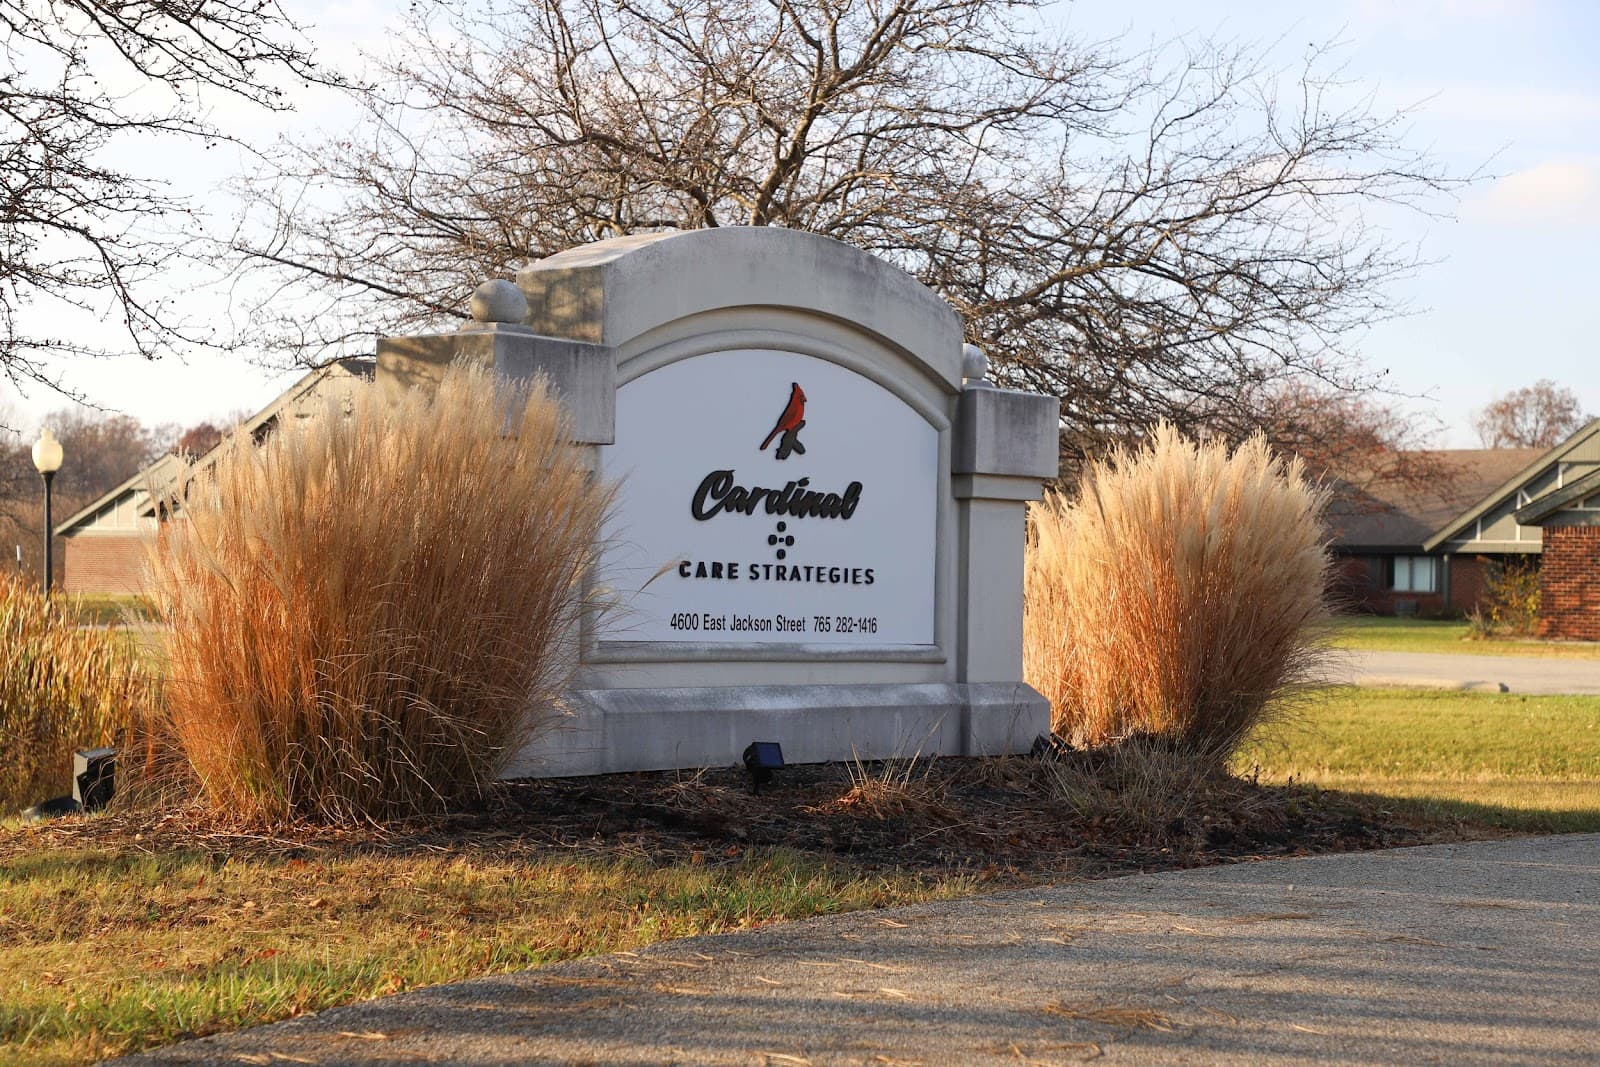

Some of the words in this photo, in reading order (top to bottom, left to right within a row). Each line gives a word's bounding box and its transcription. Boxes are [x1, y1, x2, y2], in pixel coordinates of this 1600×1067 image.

[691, 469, 863, 521] Cardinal
[679, 560, 739, 580] CARE
[749, 563, 875, 585] STRATEGIES
[670, 613, 699, 631] 4600
[703, 613, 726, 632] East
[730, 614, 772, 632] Jackson
[776, 614, 806, 633] Street
[813, 616, 831, 633] 765
[836, 616, 877, 634] 282-1416
